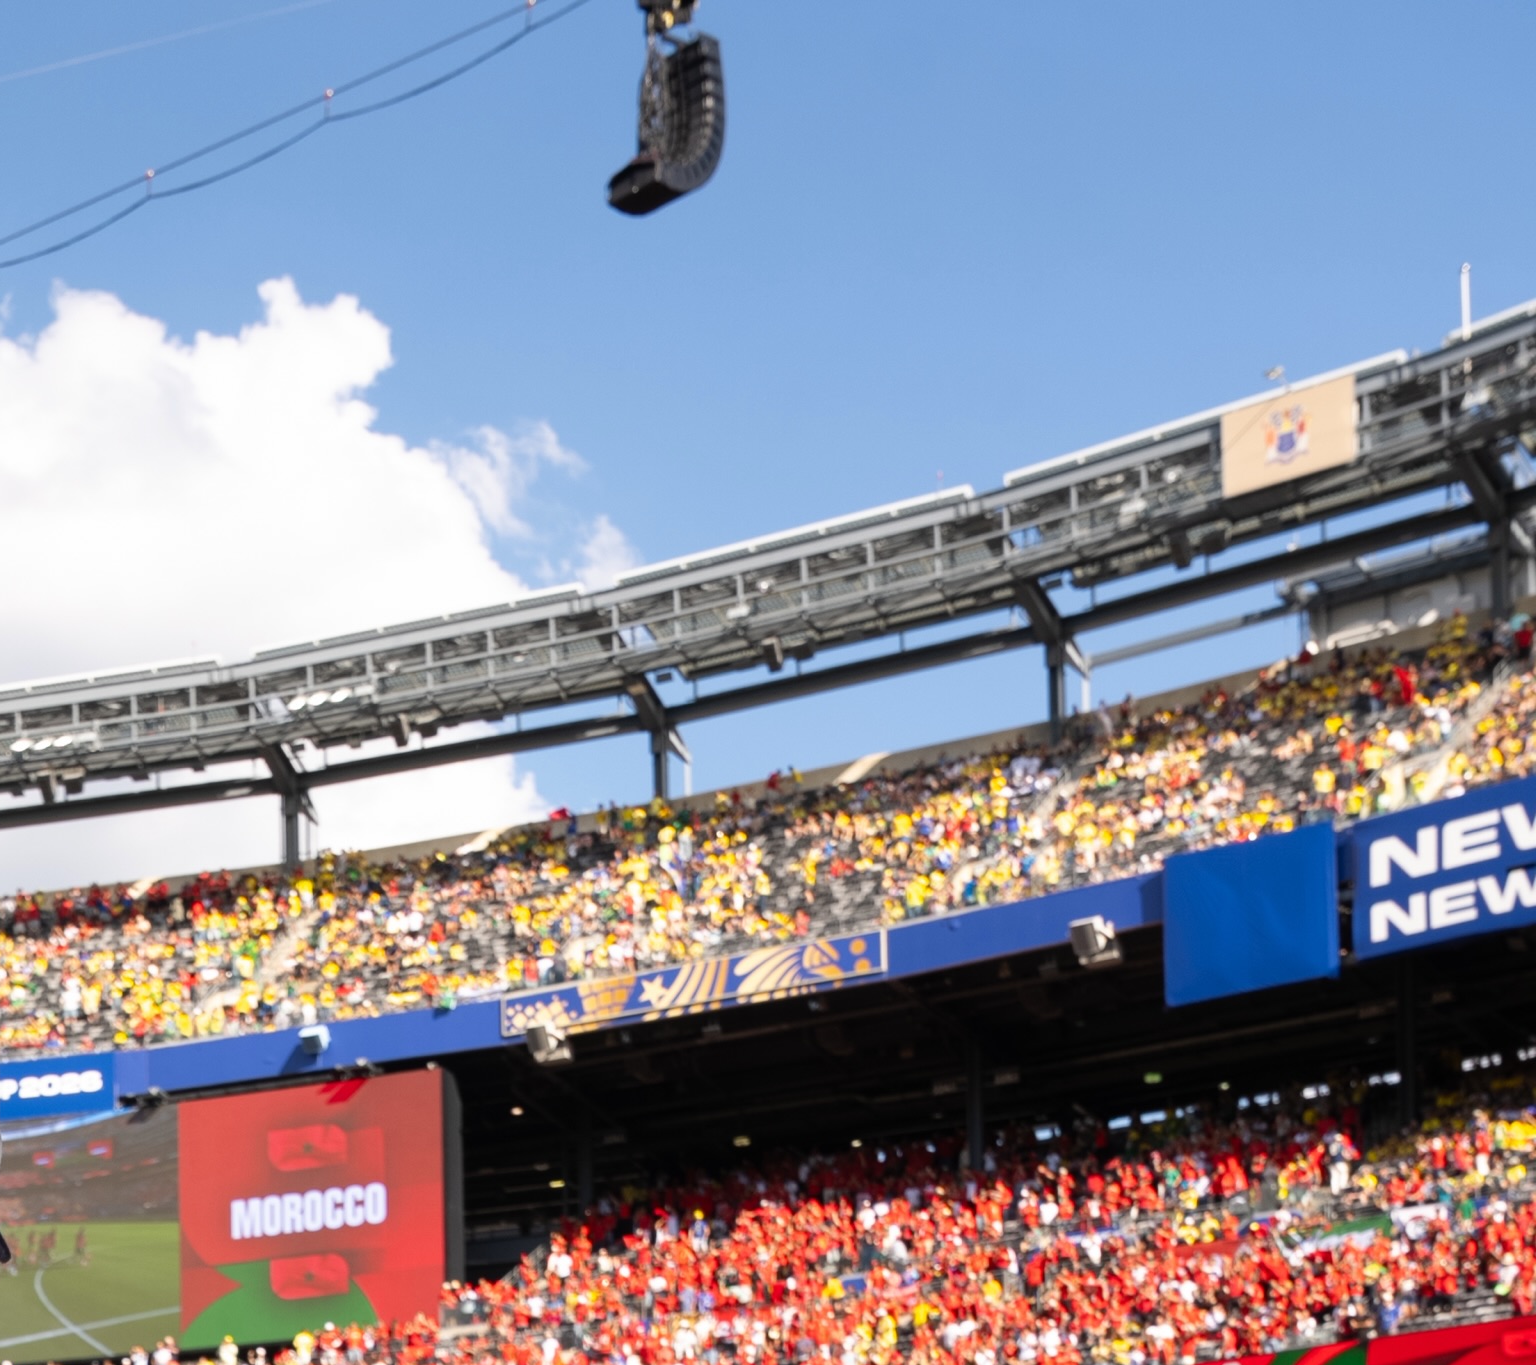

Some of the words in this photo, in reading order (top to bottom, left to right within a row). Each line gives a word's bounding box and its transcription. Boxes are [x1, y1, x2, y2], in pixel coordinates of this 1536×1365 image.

[1369, 868, 1536, 943] NEW
[18, 1071, 103, 1098] 2026
[229, 1181, 388, 1240] MOROCCO
